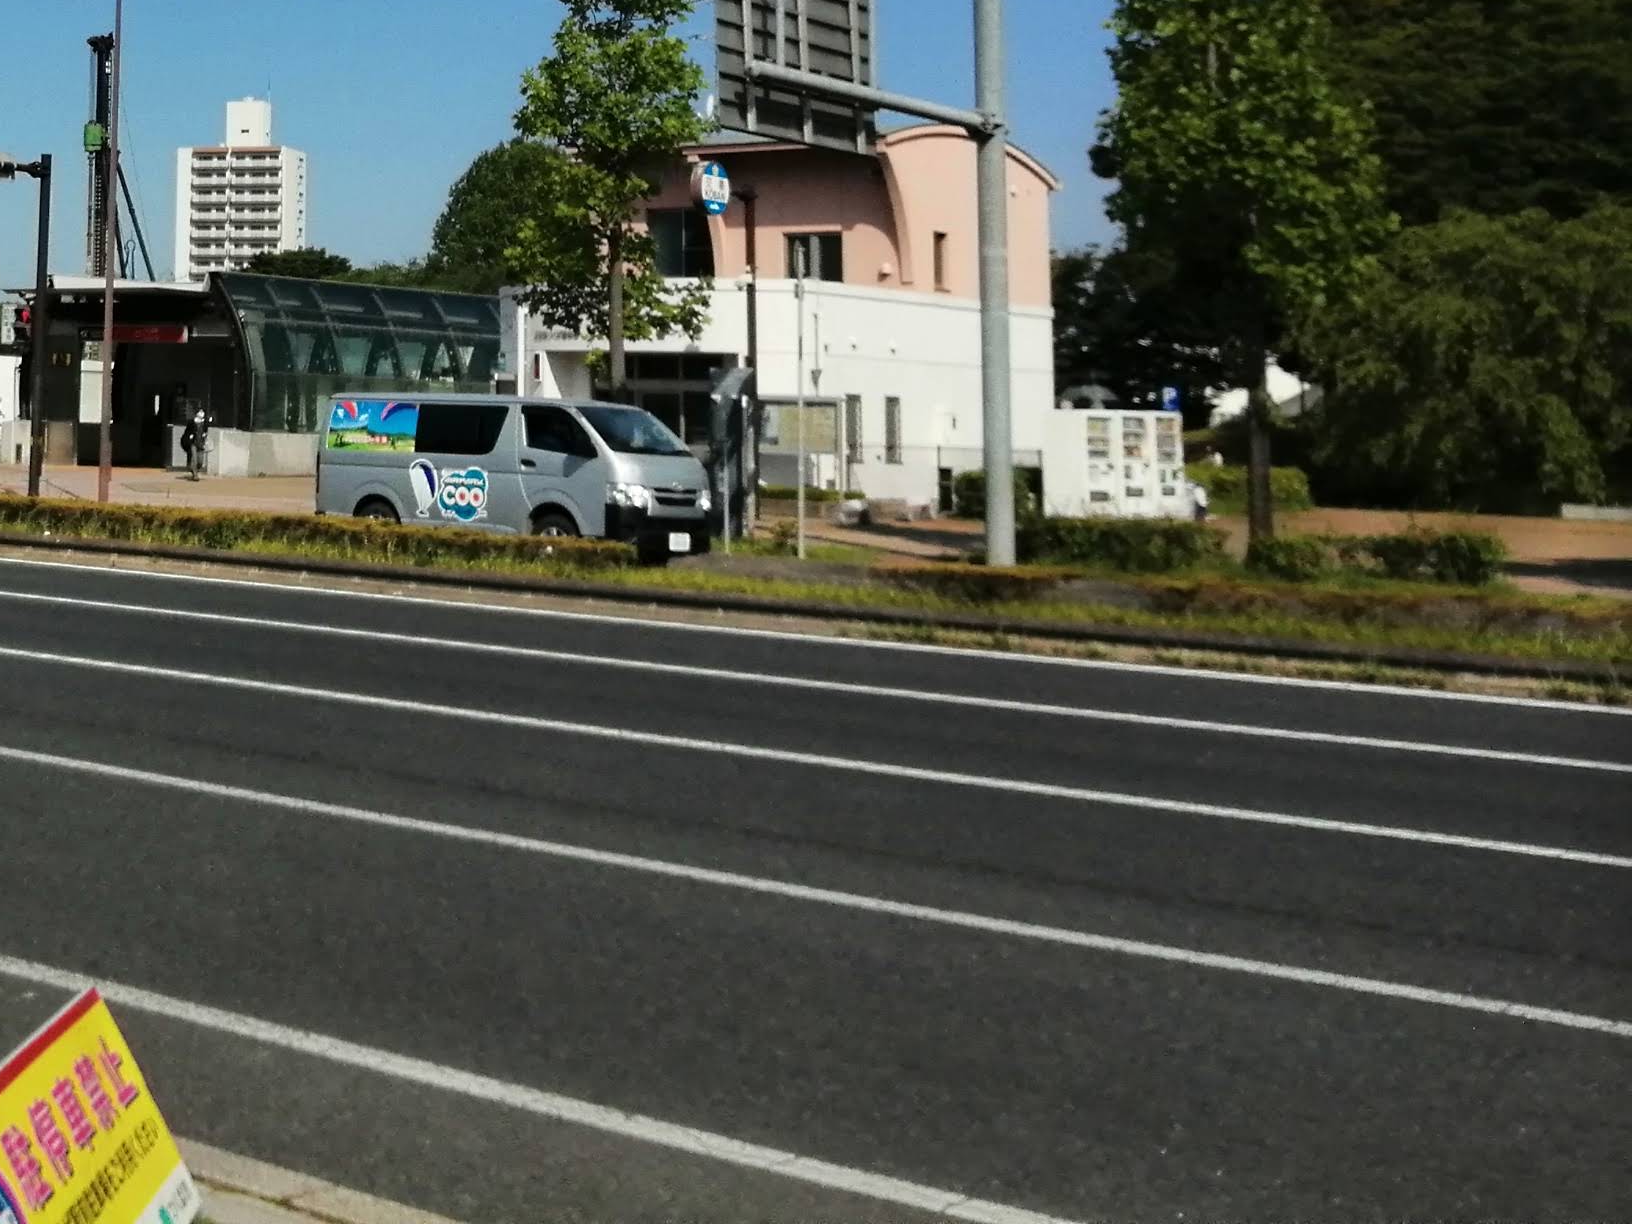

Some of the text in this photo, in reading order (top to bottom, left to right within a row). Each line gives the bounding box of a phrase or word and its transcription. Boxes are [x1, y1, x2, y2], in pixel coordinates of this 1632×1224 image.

[0, 1035, 140, 1213] 駐停車禁止
